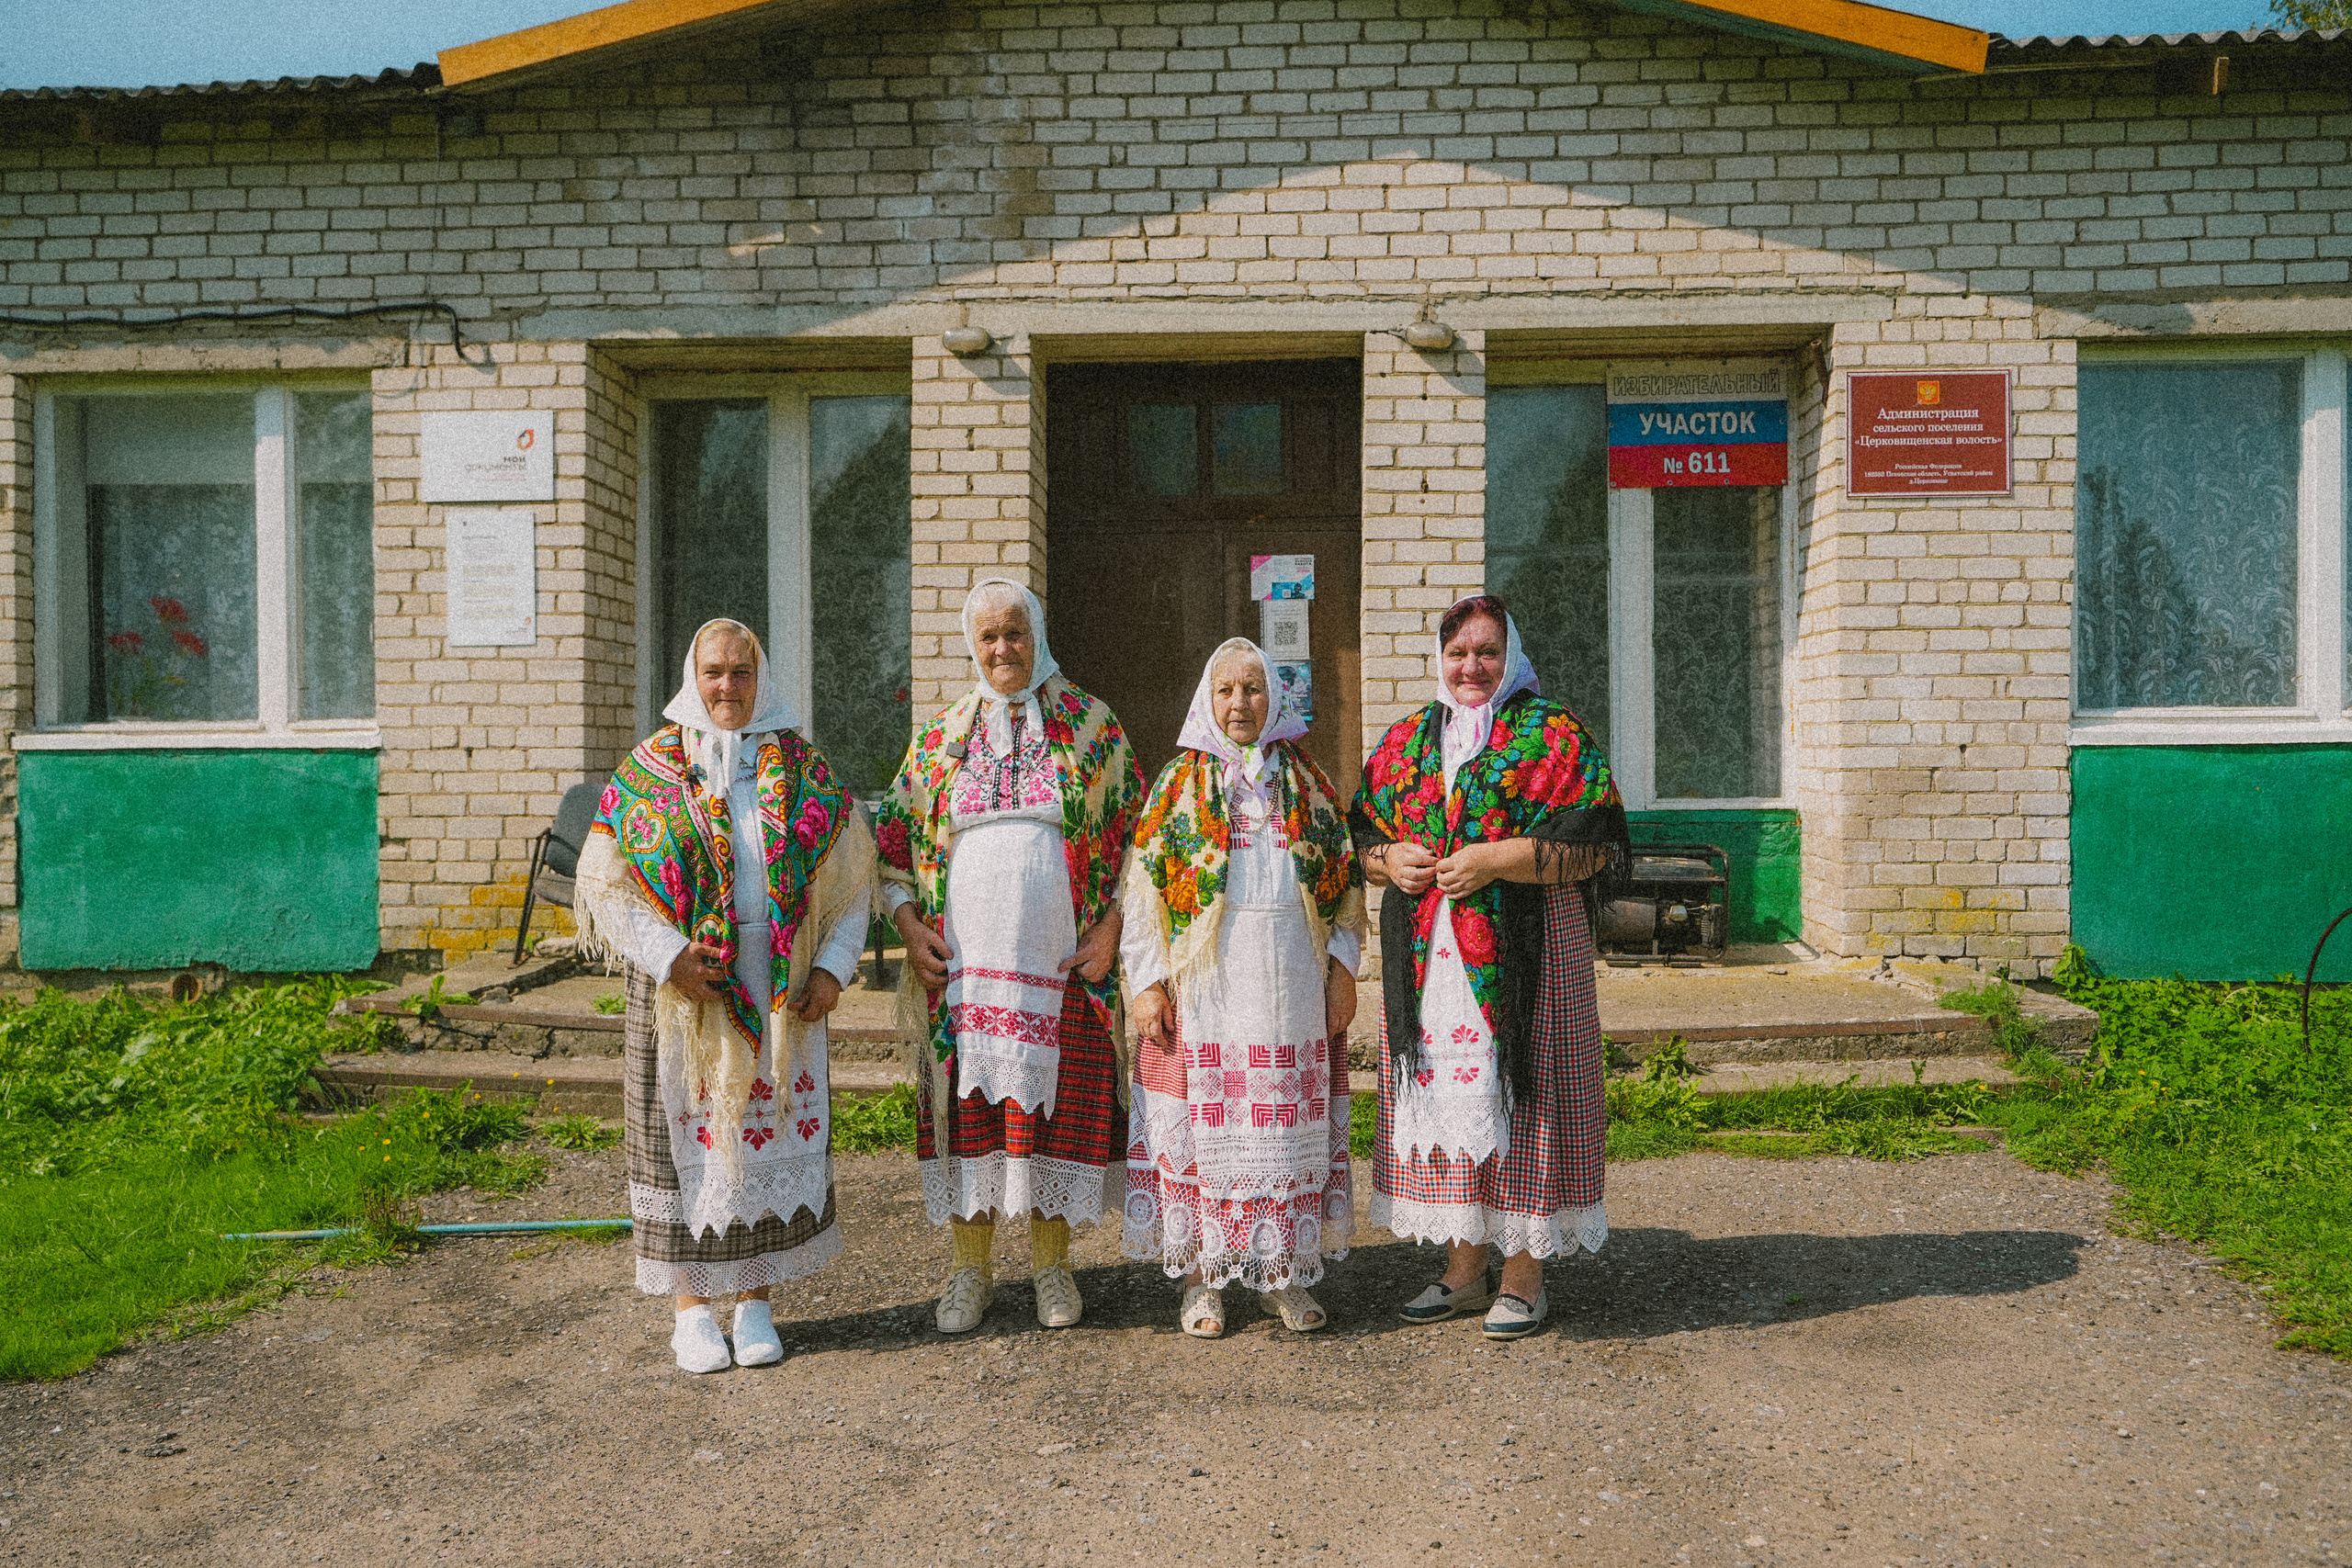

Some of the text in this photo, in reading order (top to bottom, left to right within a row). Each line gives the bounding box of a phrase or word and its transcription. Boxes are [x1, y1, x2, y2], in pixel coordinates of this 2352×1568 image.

[1612, 368, 1781, 396] ИЗБИРАТЕЛЬНЫЙ
[1638, 411, 1757, 435] УЧАСТОК
[1877, 407, 1979, 421] Администрация
[1872, 423, 1984, 433] сельского поселения
[1854, 435, 2003, 447] «Церковищенская волость»
[1663, 452, 1731, 474] № 611
